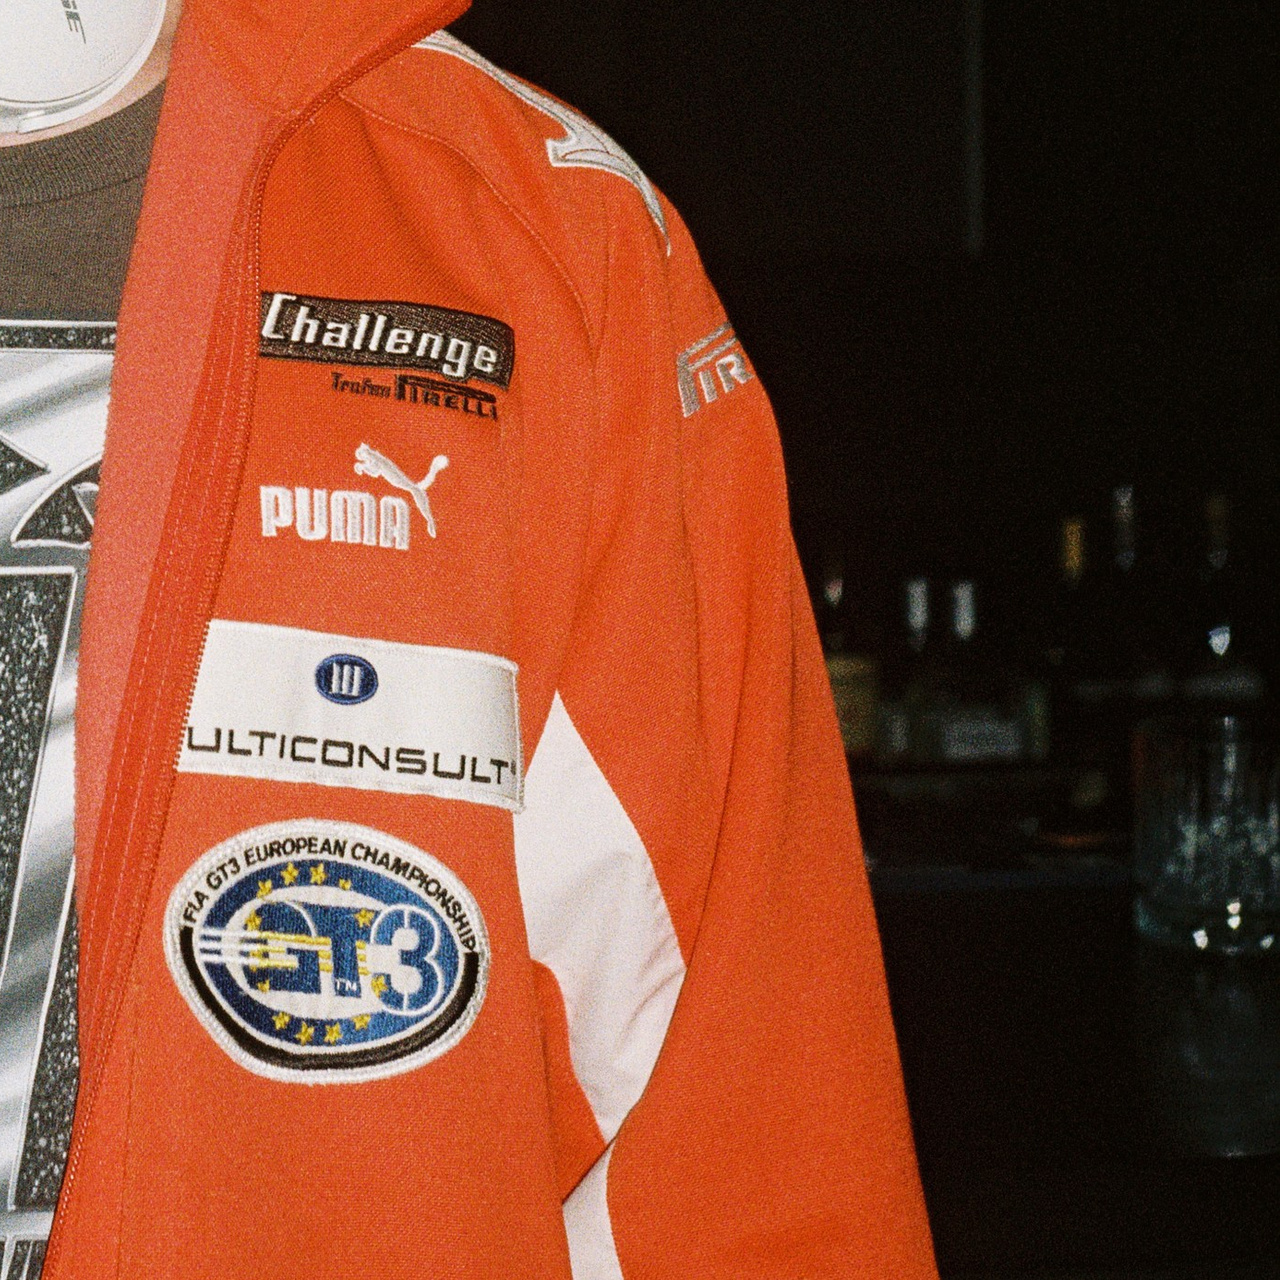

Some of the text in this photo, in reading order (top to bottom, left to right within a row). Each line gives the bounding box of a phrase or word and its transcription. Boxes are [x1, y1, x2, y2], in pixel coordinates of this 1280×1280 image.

[261, 292, 499, 378] Challenge
[394, 374, 498, 421] PIRELLI
[260, 485, 410, 550] PUMA
[183, 836, 477, 951] FIA GT3 EUROPEAN CHAMPIONSHIP
